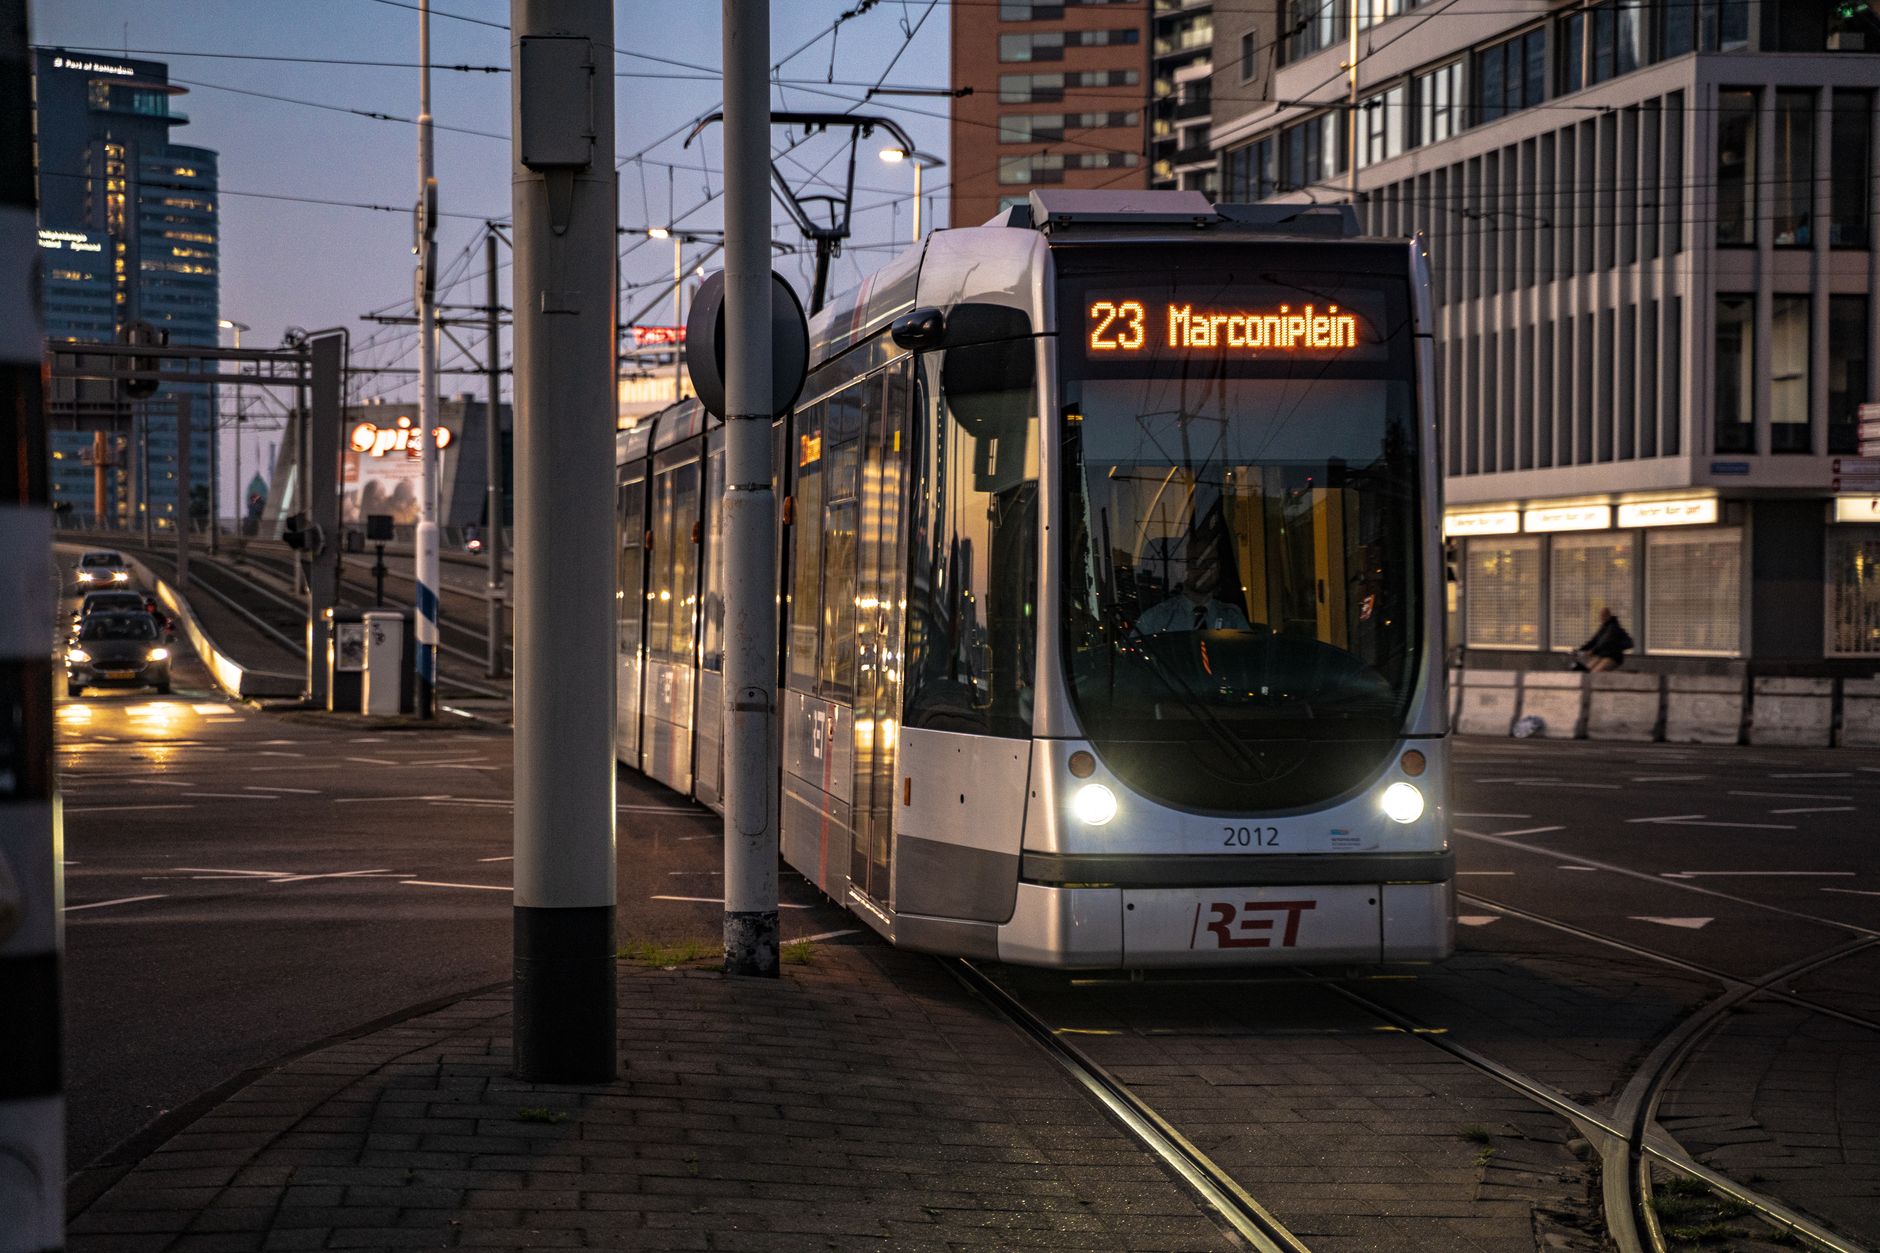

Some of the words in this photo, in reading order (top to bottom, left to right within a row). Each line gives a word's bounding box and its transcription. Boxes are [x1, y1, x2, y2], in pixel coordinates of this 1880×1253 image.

[65, 59, 82, 69] Port
[83, 62, 92, 70] of
[93, 63, 134, 75] Rotterdam
[1090, 301, 1145, 350] 23
[1167, 304, 1357, 348] Marconiplein
[1223, 826, 1279, 847] 2012
[1206, 900, 1317, 949] RET
